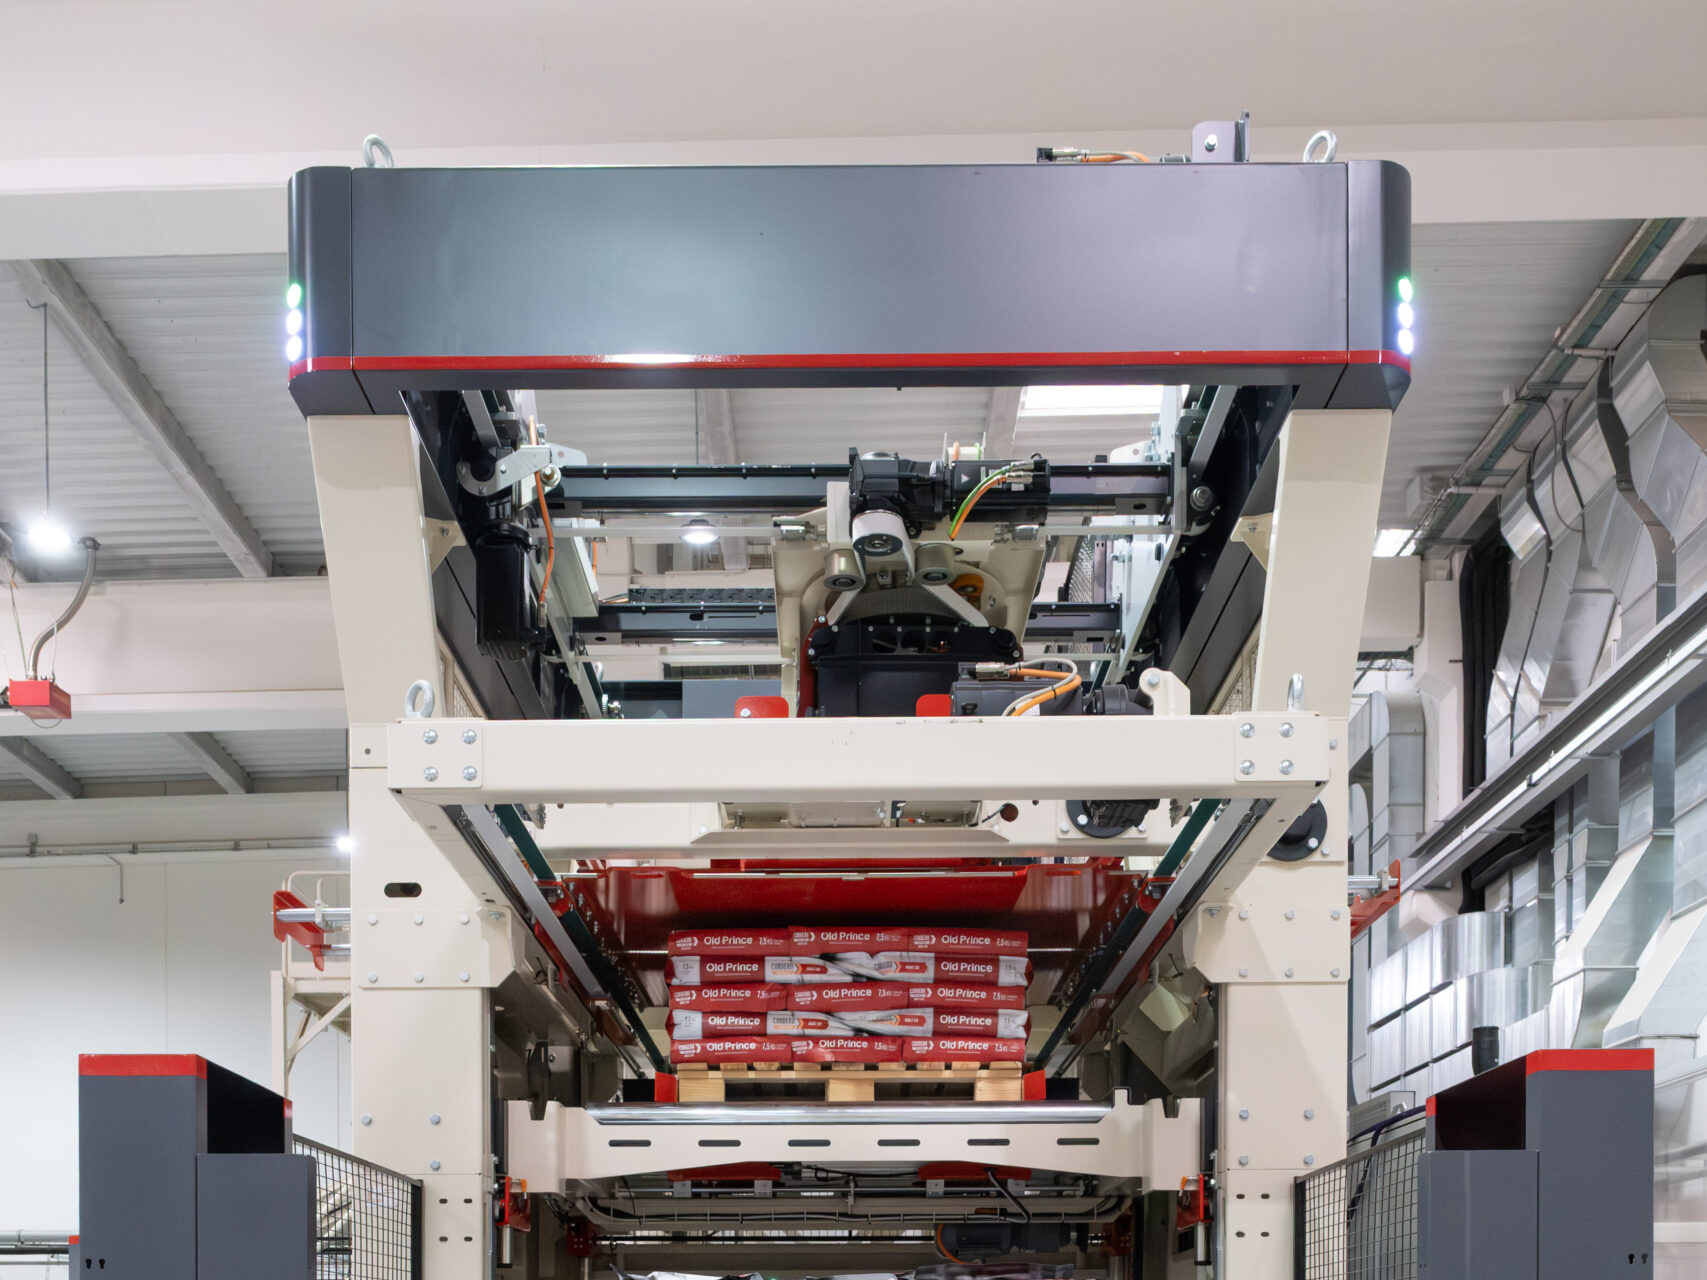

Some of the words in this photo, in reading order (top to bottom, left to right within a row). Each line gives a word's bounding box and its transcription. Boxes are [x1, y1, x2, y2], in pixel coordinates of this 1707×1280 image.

[704, 936, 721, 945] Old
[722, 936, 753, 945] Prince
[821, 932, 838, 941] Old
[839, 932, 870, 941] Prince
[941, 935, 958, 944] Old
[959, 935, 991, 945] Prince
[706, 963, 724, 972] Old
[726, 963, 759, 972] Prince
[941, 961, 959, 971] Old
[960, 962, 993, 973] Prince
[702, 989, 719, 998] Old
[720, 988, 751, 997] Prince
[823, 989, 839, 999] Old
[841, 989, 872, 998] Prince
[937, 988, 954, 997] Old
[955, 988, 987, 999] Prince
[708, 1016, 727, 1026] Old
[727, 1016, 760, 1026] Prince
[940, 1015, 958, 1024] Old
[959, 1015, 992, 1026] Prince
[706, 1042, 724, 1051] Old
[724, 1042, 757, 1050] Prince
[819, 1040, 836, 1049] Old
[837, 1039, 868, 1048] Prince
[939, 1040, 957, 1049] Old
[957, 1040, 989, 1050] Prince
